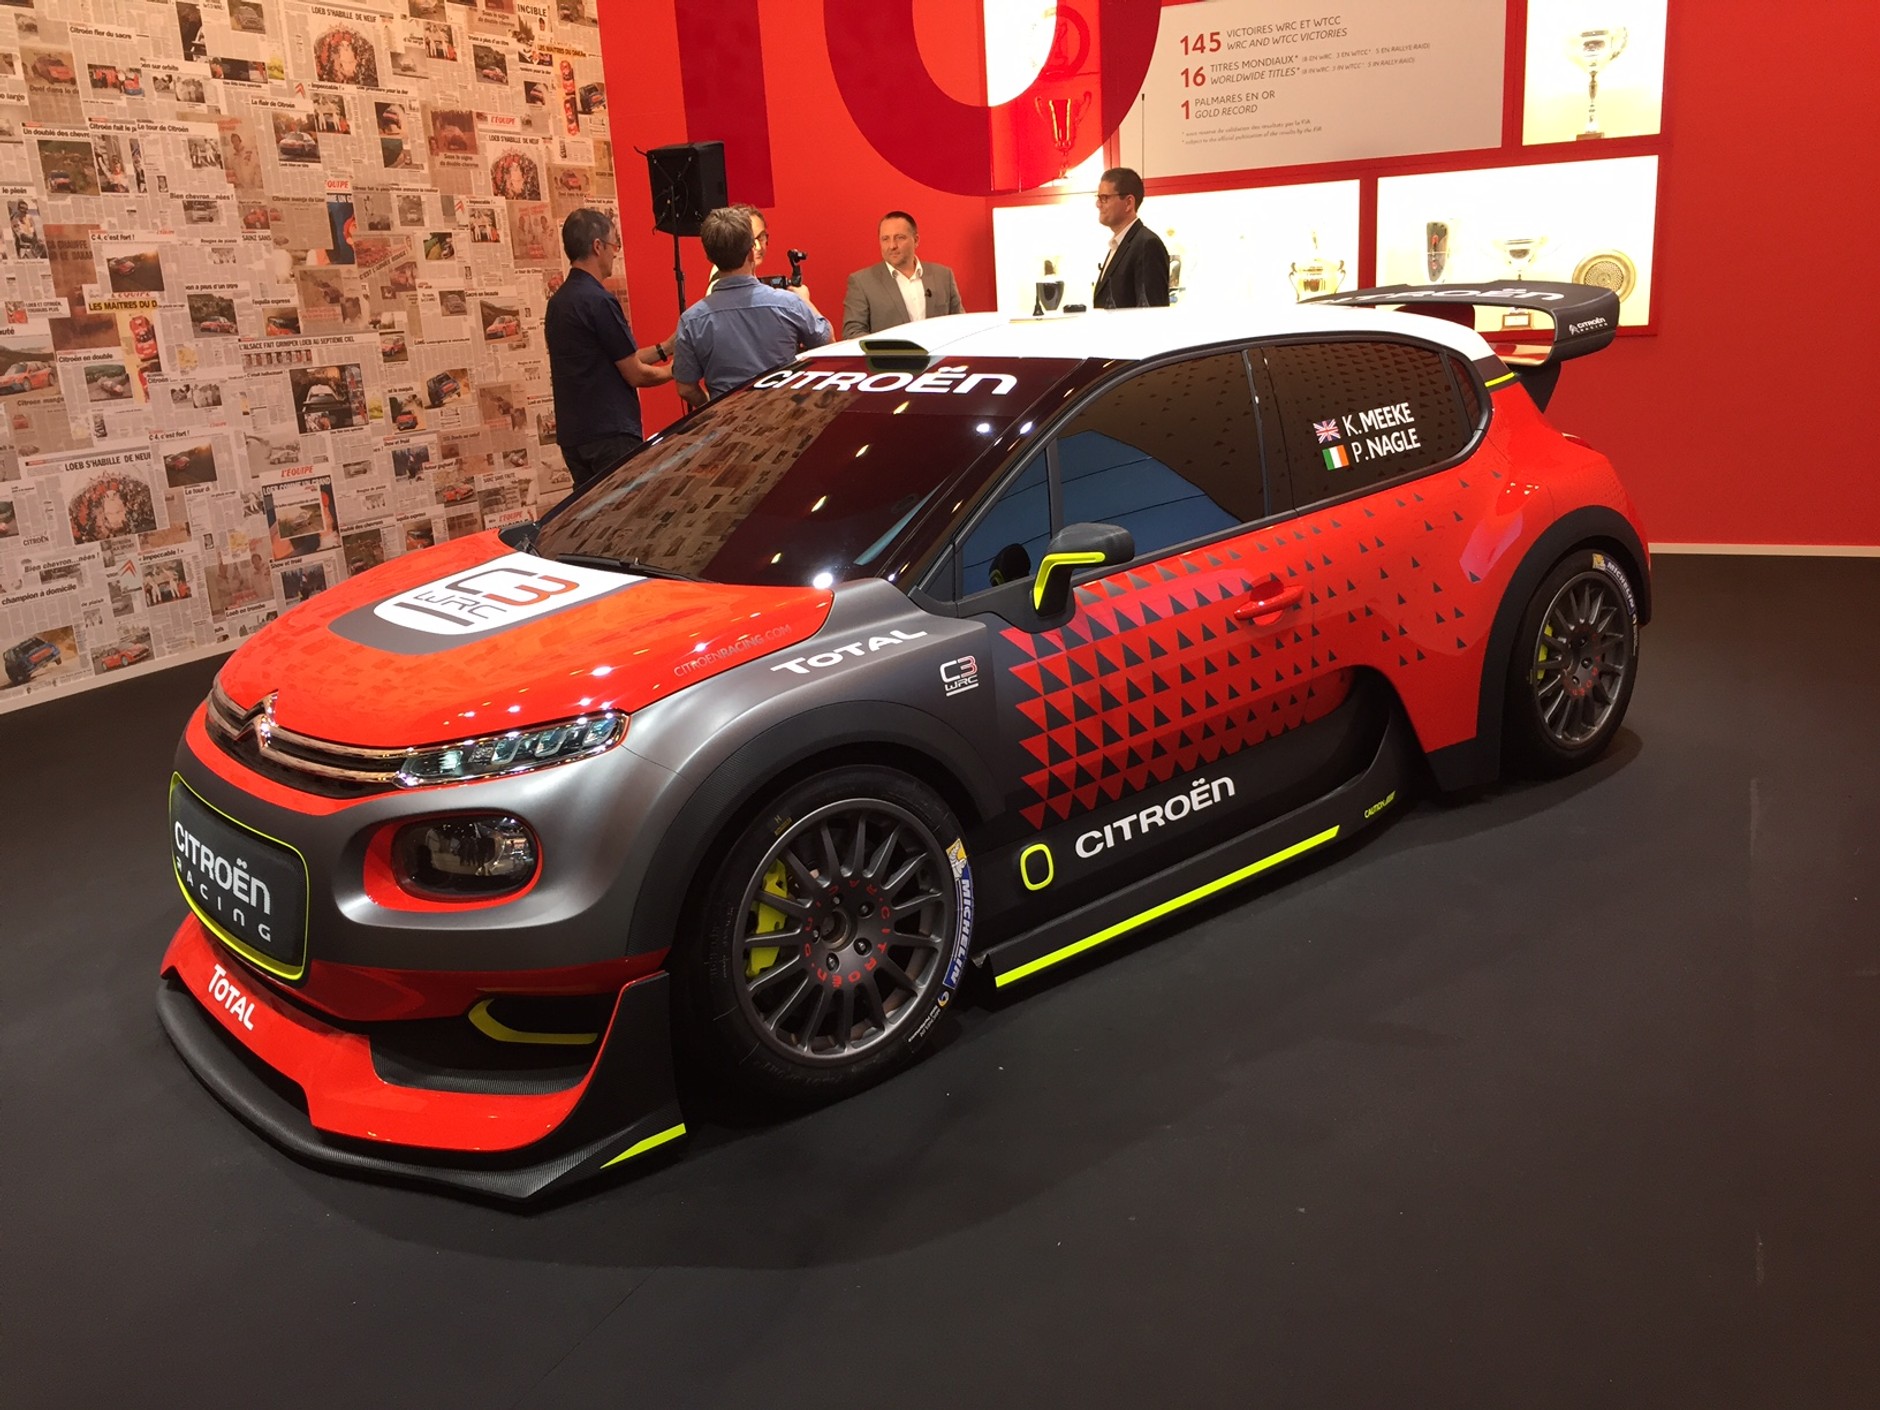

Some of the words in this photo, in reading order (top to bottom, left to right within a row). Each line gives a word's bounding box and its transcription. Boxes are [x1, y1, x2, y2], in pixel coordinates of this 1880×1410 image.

[1226, 24, 1273, 38] VICTOIRES
[1275, 21, 1298, 33] WRC
[1300, 20, 1311, 30] ET
[1313, 16, 1341, 28] WTCC
[1180, 32, 1222, 56] 145
[1226, 39, 1248, 51] WRC
[1248, 36, 1270, 48] AND
[1272, 34, 1299, 45] WTCC
[1300, 28, 1348, 42] VICTORIES
[1180, 66, 1206, 88] 16
[1210, 61, 1239, 73] TITRES
[1210, 70, 1265, 86] WORLDWIDE
[1181, 100, 1190, 120] 1
[1194, 93, 1243, 106] PALMARES
[1246, 92, 1259, 101] EN
[1262, 90, 1276, 100] OR
[1194, 108, 1220, 119] GOLD
[1222, 104, 1258, 117] RECORD
[89, 302, 102, 311] LES
[139, 300, 149, 309] DU
[752, 364, 1018, 395] CITROËN
[64, 461, 85, 472] LOEB
[86, 457, 121, 469] S'HABILLE
[124, 455, 134, 463] DE
[1607, 562, 1635, 608] MICHELIN
[414, 590, 508, 620] WRC
[672, 624, 793, 678] CITROENRACING.COM
[770, 628, 928, 675] TOTAL
[940, 655, 978, 684] C3
[944, 674, 979, 692] WRC
[1075, 776, 1236, 859] CITROËN
[174, 821, 271, 916] CITROËN
[176, 856, 272, 943] RACING
[950, 878, 972, 984] MICHELIN
[208, 964, 255, 1031] TOTAL
